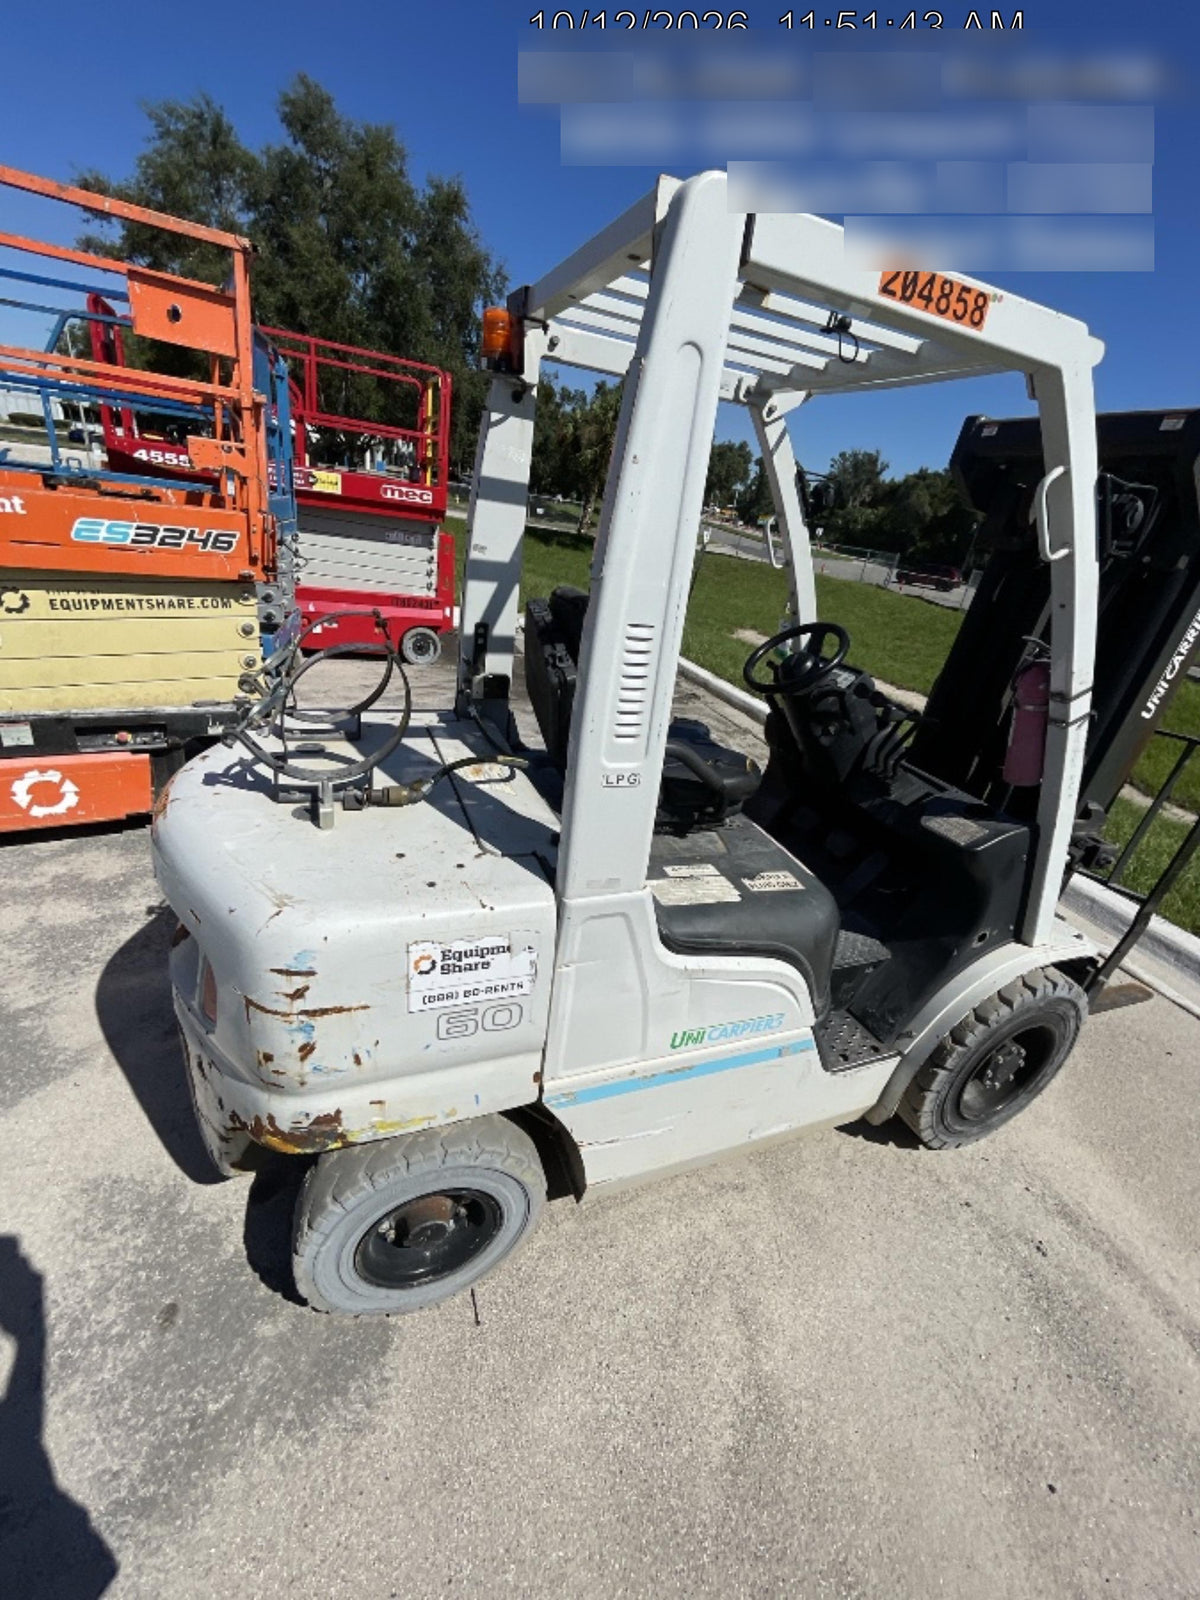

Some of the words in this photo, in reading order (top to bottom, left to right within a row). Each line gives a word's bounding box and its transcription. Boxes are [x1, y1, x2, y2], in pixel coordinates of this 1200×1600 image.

[881, 271, 988, 327] 204858
[381, 485, 432, 503] mec
[72, 518, 239, 552] ES3246
[49, 597, 232, 611] EQUIPMENTSHARE.COM
[605, 773, 638, 785] LPG
[440, 960, 491, 975] Share
[437, 1002, 523, 1040] 60
